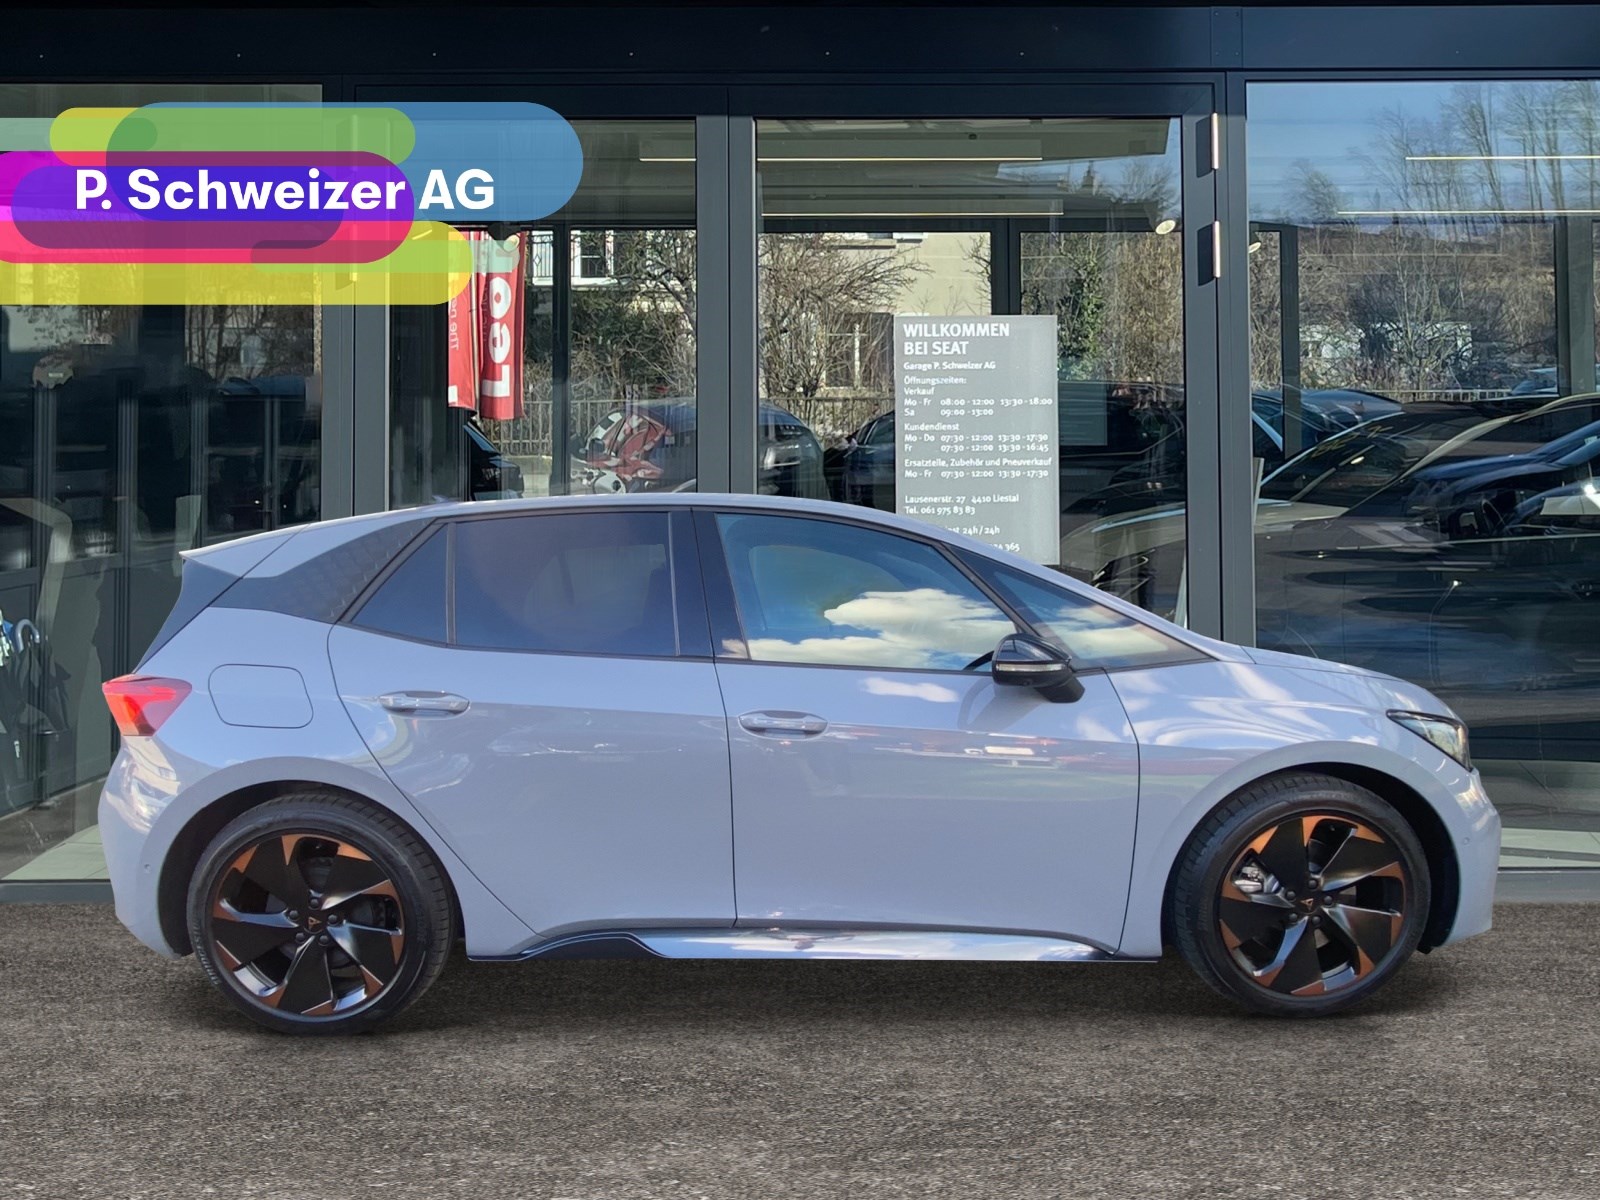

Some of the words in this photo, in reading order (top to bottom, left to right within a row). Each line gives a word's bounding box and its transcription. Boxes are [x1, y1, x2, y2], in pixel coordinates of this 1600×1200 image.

[902, 322, 1010, 338] WILLKOMMEN
[904, 341, 928, 355] BEI
[932, 341, 969, 355] SEAT
[903, 362, 932, 371] Garage
[942, 361, 983, 370] Schweizer
[984, 361, 996, 370] AG
[904, 387, 935, 395] Verkauf
[904, 398, 917, 406] Mo
[923, 398, 932, 406] Fr
[940, 398, 966, 406] 08:00
[1000, 398, 1023, 407] 13:30
[1029, 397, 1053, 405] 18:00
[904, 408, 915, 416] Sa
[940, 409, 965, 418] 09:00
[971, 409, 994, 417] 13:00
[904, 422, 960, 431] Kundendienst
[904, 434, 918, 442] Mo
[924, 433, 936, 442] Do
[940, 435, 965, 443] 07:30
[998, 434, 1021, 443] 13:30
[1026, 434, 1048, 442] 17:30
[904, 444, 913, 452] Fr
[940, 444, 965, 453] 07:30
[998, 444, 1021, 453] 13:30
[1026, 442, 1049, 452] 16:45
[950, 458, 984, 466] Zubehör
[985, 458, 1000, 466] und
[1002, 457, 1052, 466] Pneuverkauf
[904, 469, 918, 478] Mo
[924, 469, 932, 478] Fr
[941, 471, 965, 479] 07:30
[998, 470, 1021, 479] 13:30
[1027, 470, 1049, 479] 17:30
[905, 495, 954, 504] Lausenerstr.
[956, 496, 966, 505] 27
[971, 496, 992, 504] 4410
[993, 493, 1020, 503] Liestal
[904, 506, 920, 514] Tel.
[920, 506, 936, 514] 061
[937, 507, 952, 516] 975
[953, 505, 964, 516] 83
[965, 505, 976, 516] 83
[962, 525, 978, 536] 24h
[984, 525, 1000, 536] 24h
[1005, 542, 1020, 552] 365
